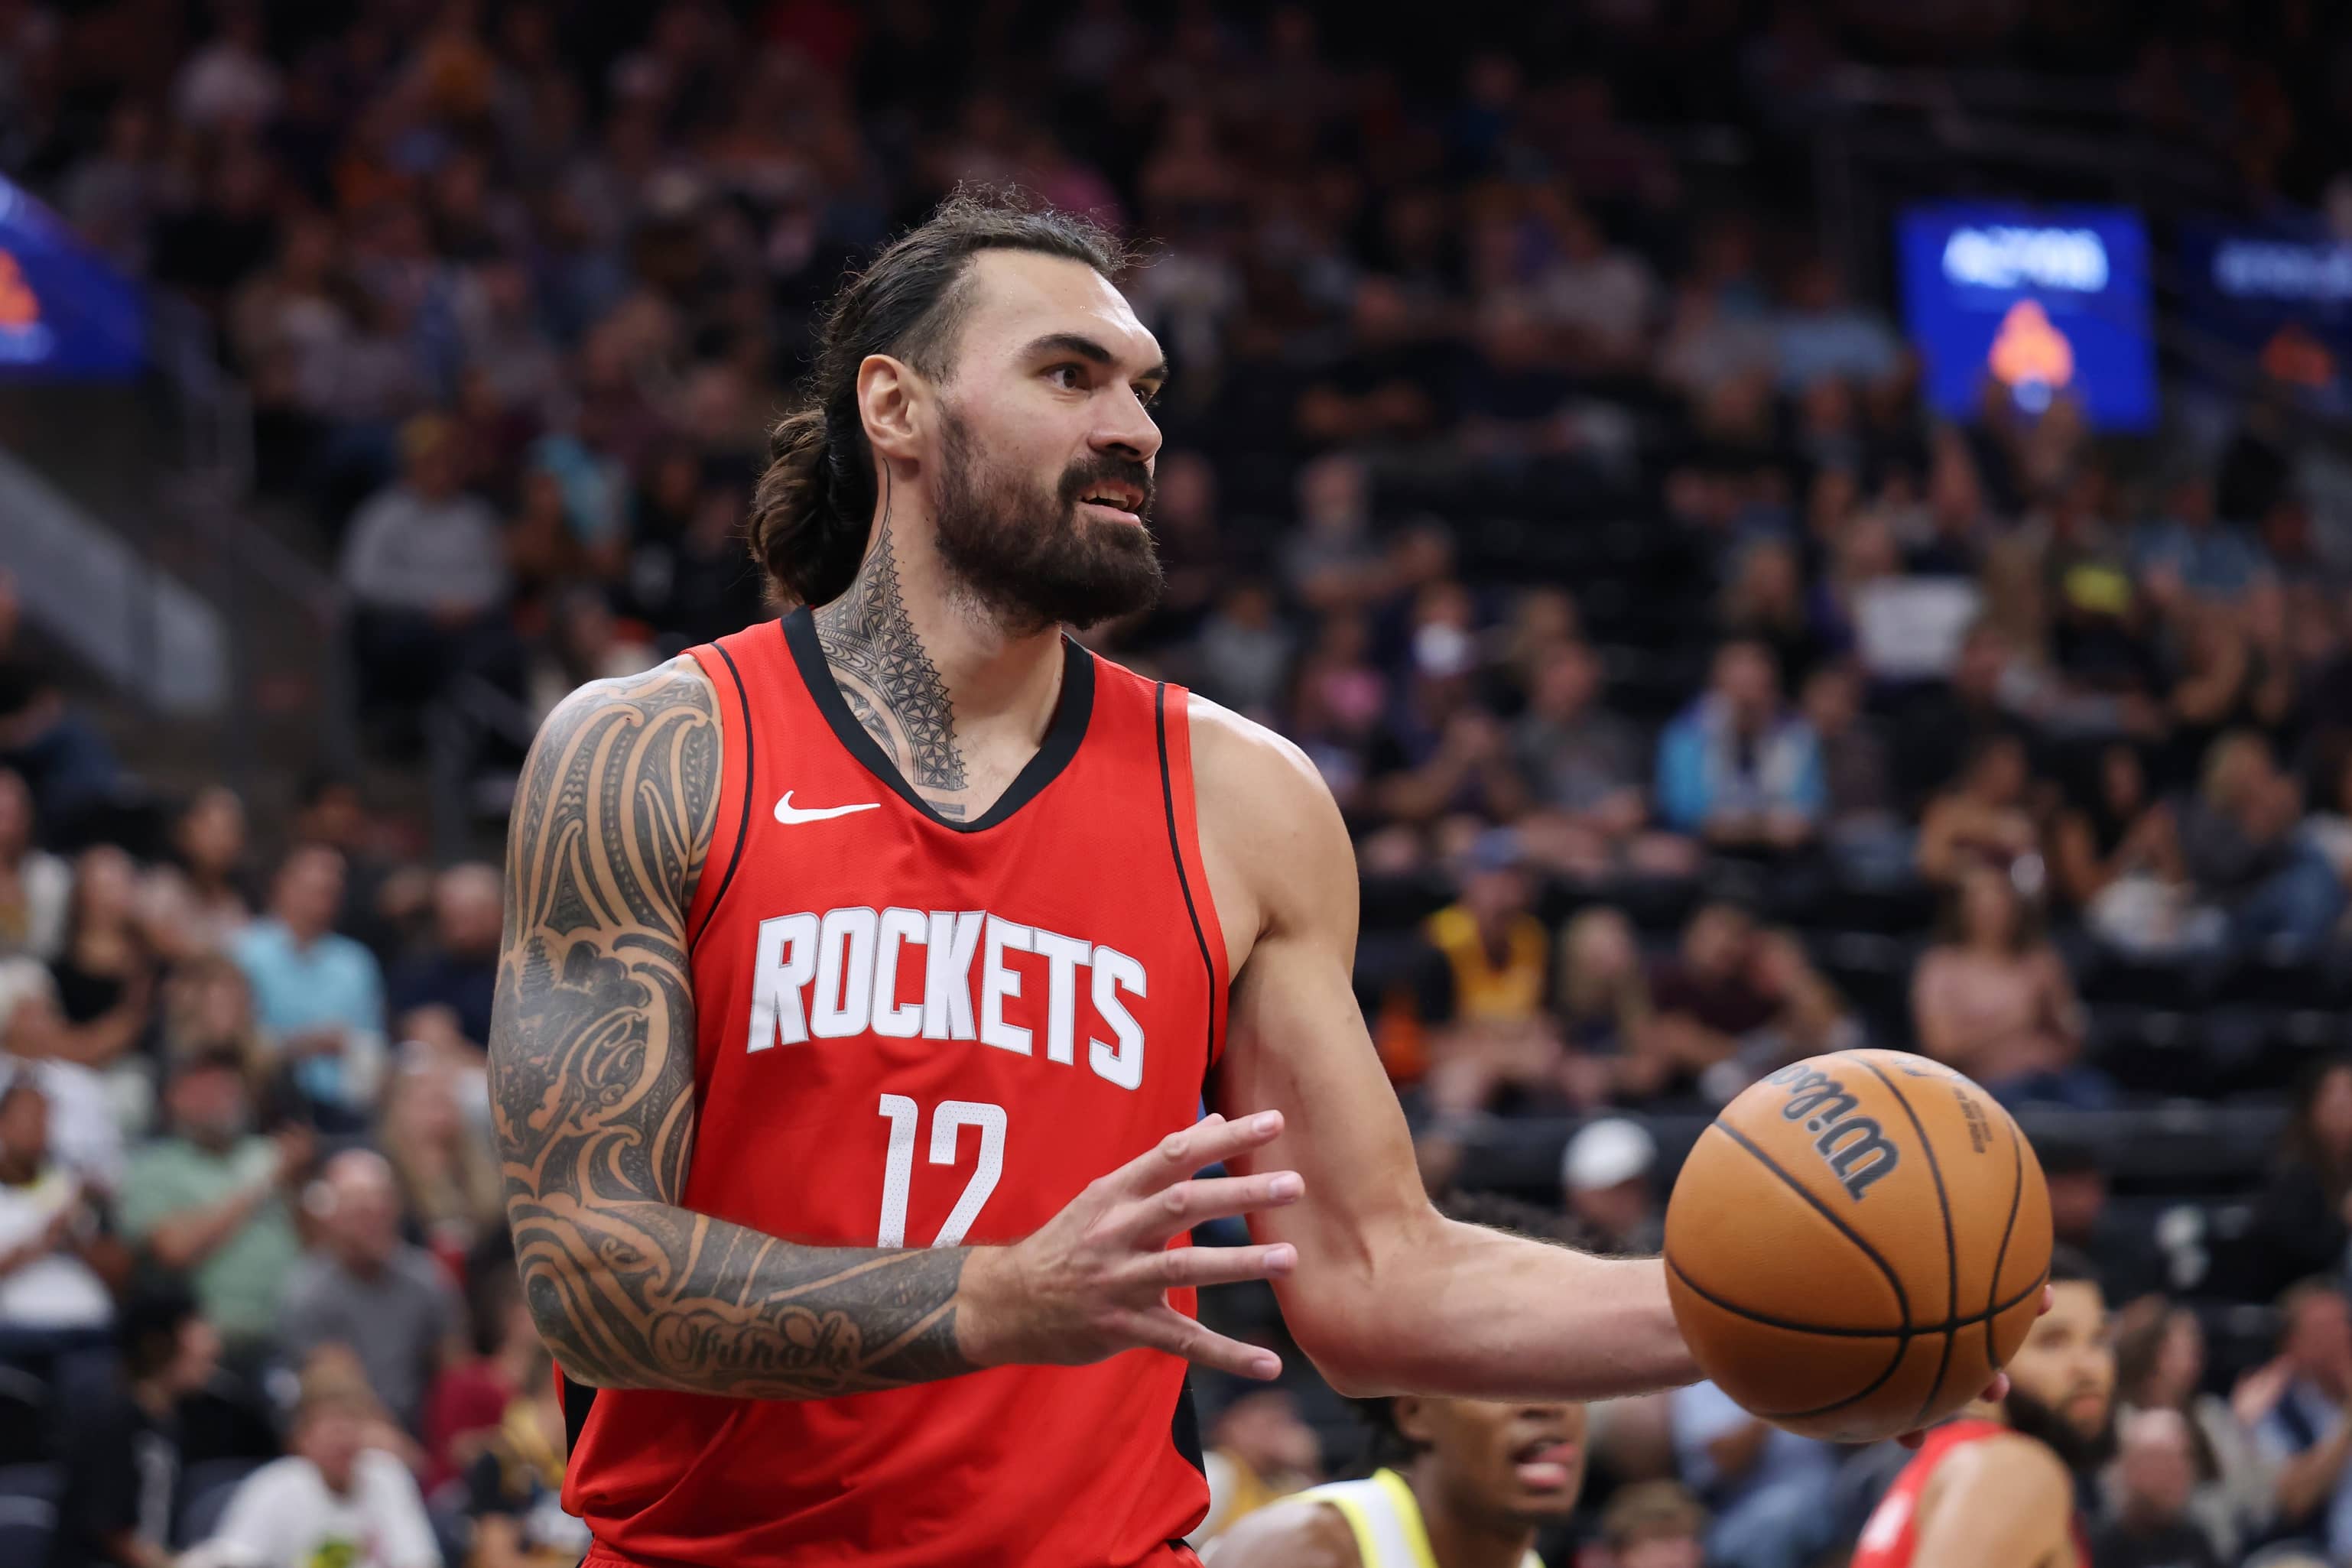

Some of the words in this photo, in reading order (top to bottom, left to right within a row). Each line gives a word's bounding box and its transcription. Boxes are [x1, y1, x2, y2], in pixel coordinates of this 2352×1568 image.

[747, 906, 1147, 1090] ROCKETS
[878, 1093, 1007, 1248] 12
[1763, 1064, 1899, 1202] Wilso
